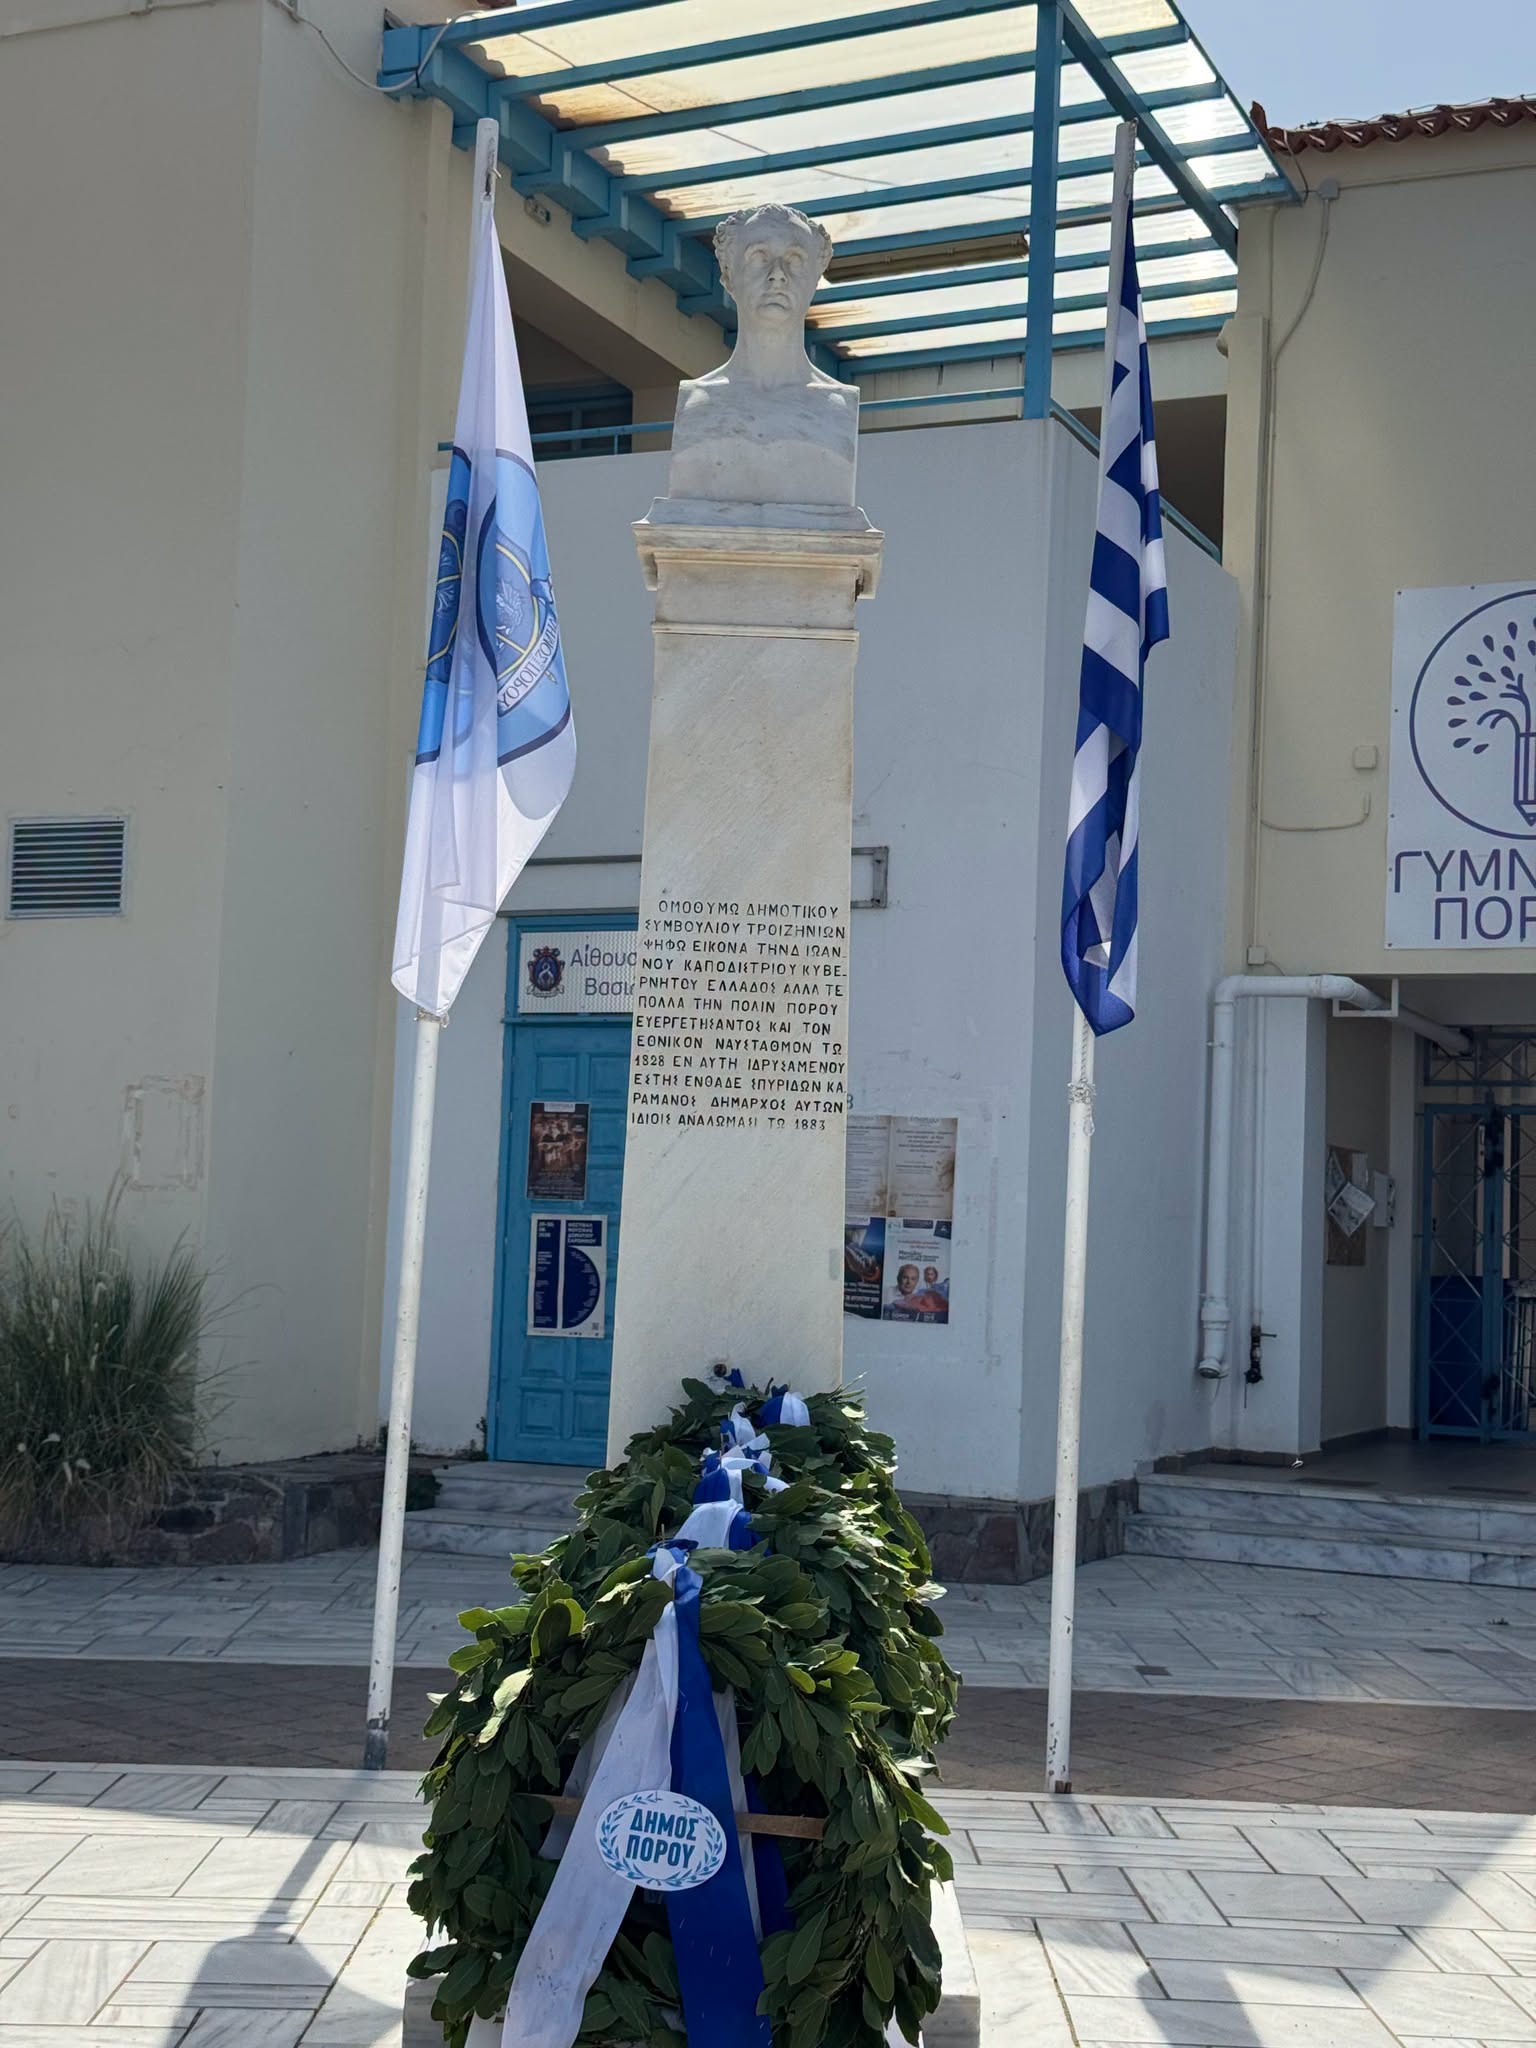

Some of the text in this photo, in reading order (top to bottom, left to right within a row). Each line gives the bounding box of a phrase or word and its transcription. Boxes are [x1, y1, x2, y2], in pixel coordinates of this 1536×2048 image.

[659, 900, 838, 918] ΟΜΟΘΥΜΩ ΔΗΜΟΤΙΚΟΥ
[645, 920, 845, 938] ΣΥΜΒΟΥΛΙΟΥ ΤΡΟΙΖΗΝΙΩΝ
[644, 939, 685, 952] ΨΗΦΩ
[693, 941, 747, 954] ΕΙΚΟΝΑ
[642, 958, 673, 970] ΝΟΥ
[685, 960, 797, 975] ΚΑΠΟΔΙΣΤΡΙΟΥ
[640, 976, 698, 990] ΡΝΗΤΟΥ
[708, 979, 776, 994] ΕΛΛΑΔΟΣ
[826, 985, 843, 997] ΤΕ
[639, 996, 838, 1015] ΠΟΛΛΑ ΤΗΝ ΠΟΛΙΝ ΠΟΡΟΥ
[636, 1016, 830, 1035] ΕΥΕΡΓΕΤΗΣΑΝΤΟΣ ΚΑΙ ΤΟΝ
[637, 1035, 842, 1055] ΕΘΝΙΚΟΝ ΝΑΥΣΤΑΘΜΟΝ ΤΩ
[635, 1055, 845, 1074] 1828 ΕΝ ΑΥΤΗ ΙΔΡΥΣΑΜΕΝΟΥ
[685, 1075, 742, 1089] ΕΝΘΑΔΕ
[752, 1078, 821, 1092] ΣΠΥΡΙΔΩΝ
[633, 1093, 696, 1106] ΡΑΜΑΝΟΣ
[711, 1096, 785, 1111] ΔΗΜΑΡΧΟΣ
[795, 1101, 843, 1113] ΑΥΤΩΝ
[678, 1114, 757, 1128] ΑΝΑΛΩΜΑΣΙ
[768, 1117, 785, 1129] ΤΩ
[630, 1808, 699, 1841] ΔΗΜΟΣ
[625, 1834, 695, 1869] ΠΟΡΟΥ
